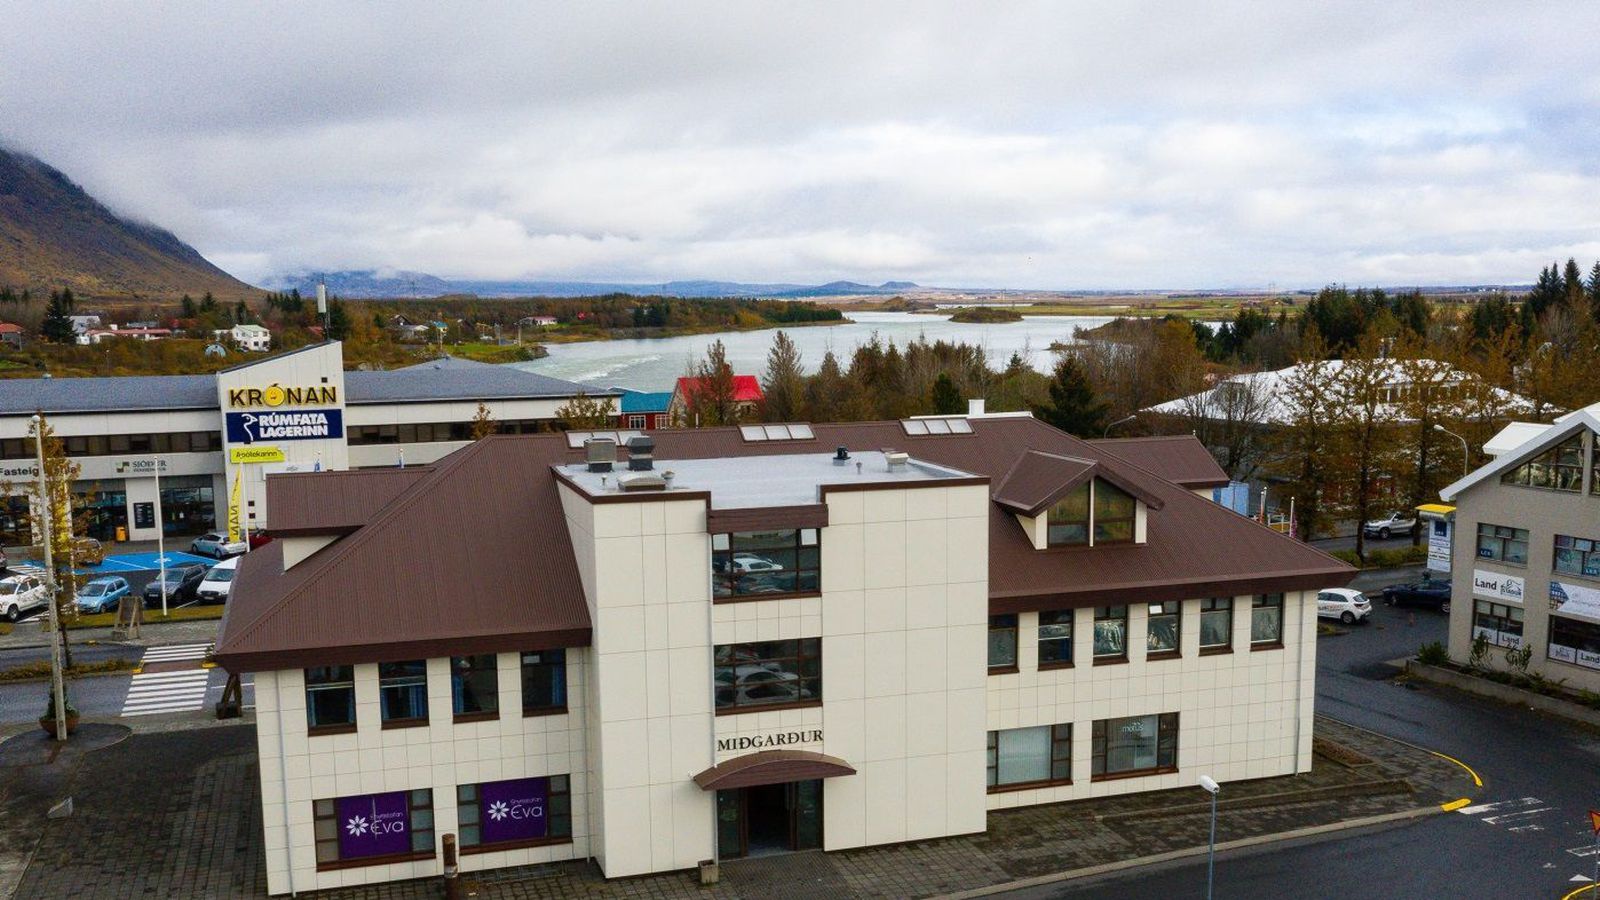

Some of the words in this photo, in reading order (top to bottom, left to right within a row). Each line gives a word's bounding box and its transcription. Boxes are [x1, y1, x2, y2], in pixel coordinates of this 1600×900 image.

[230, 383, 337, 407] KRÓNAN
[259, 412, 328, 427] RÚMFATA
[260, 425, 328, 438] LAGERINN
[1475, 578, 1497, 591] Land
[1502, 635, 1520, 645] Land
[717, 729, 824, 752] MIÐGARÐUR
[510, 804, 543, 820] Eva
[370, 820, 404, 835] Eva
